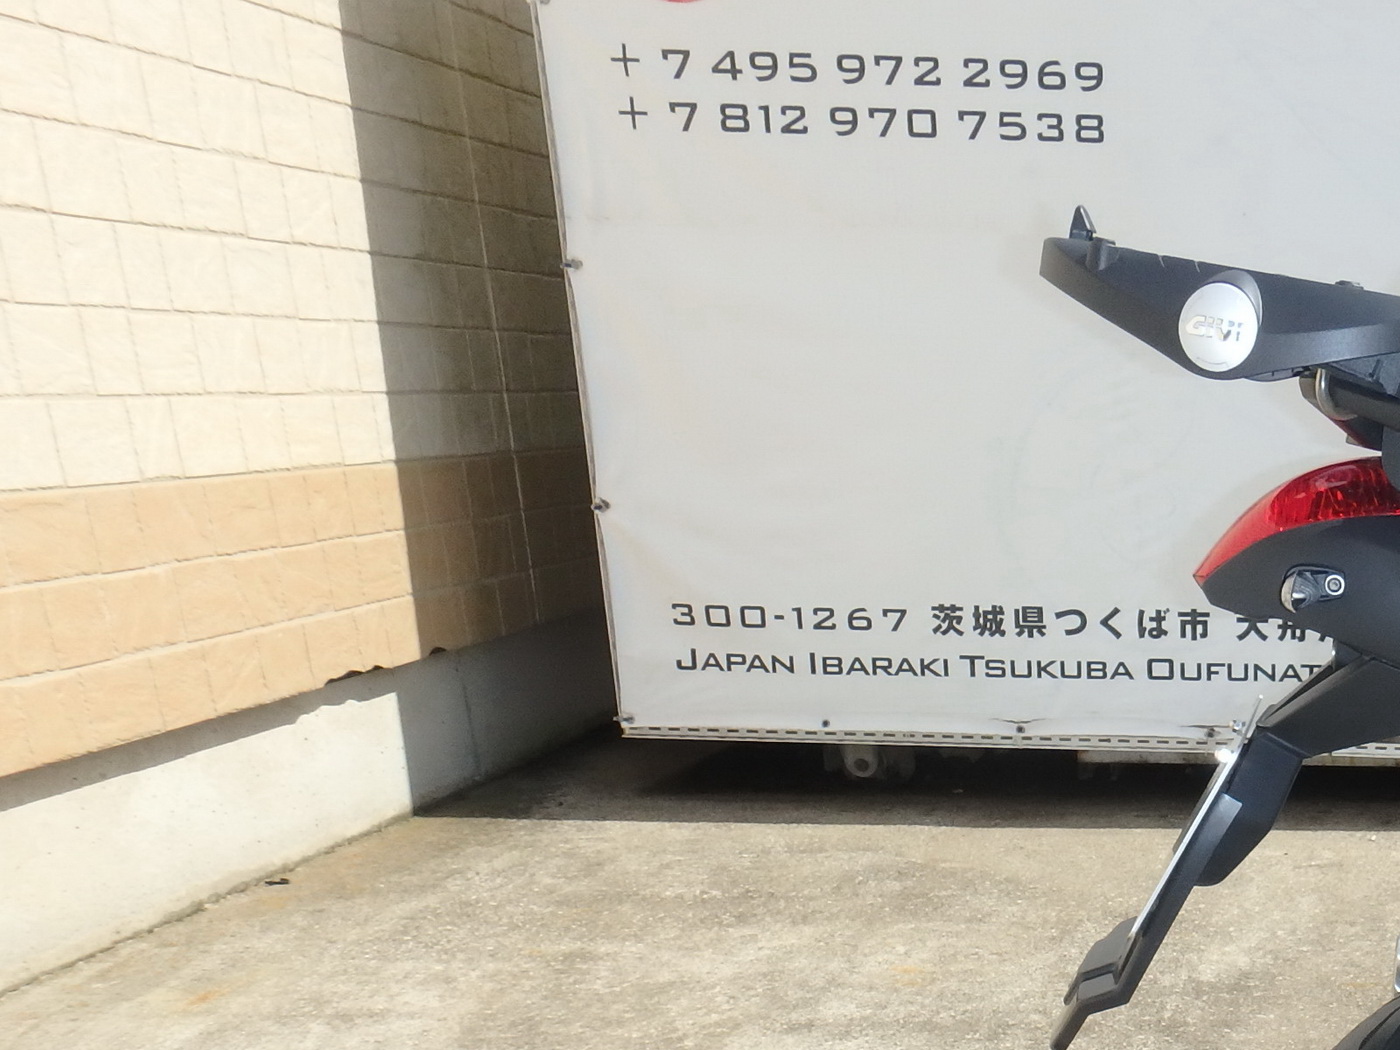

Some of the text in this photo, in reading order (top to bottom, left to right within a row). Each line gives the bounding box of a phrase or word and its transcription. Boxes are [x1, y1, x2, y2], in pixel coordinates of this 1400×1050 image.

[661, 48, 691, 80] 7
[711, 50, 818, 83] 495
[836, 53, 942, 87] 972
[962, 57, 1104, 92] 2969
[668, 101, 698, 132] 7
[719, 102, 809, 135] 812
[829, 106, 938, 139] 970
[957, 109, 1105, 144] 7538
[671, 602, 908, 632] 300-1267
[930, 603, 1211, 642] 茨城県つくば市
[675, 647, 795, 675] JAPAN
[809, 652, 950, 678] IBARAKI
[958, 654, 1135, 681] TSUKUBA
